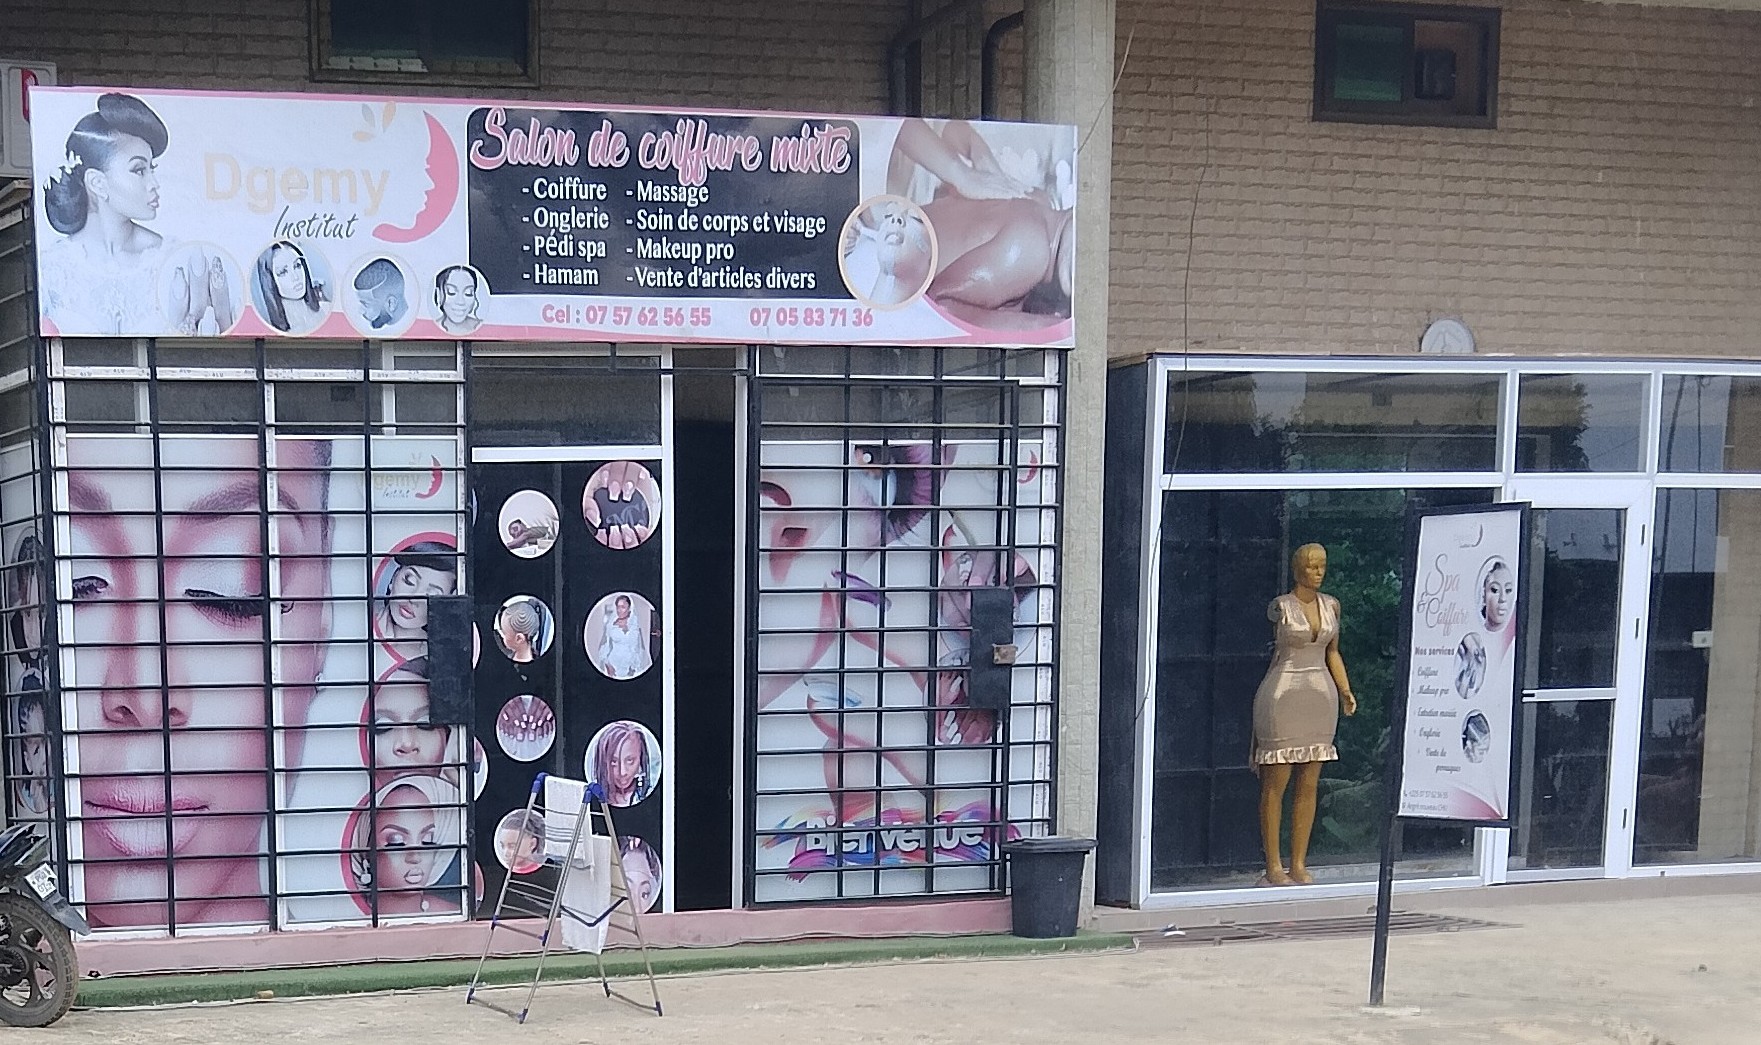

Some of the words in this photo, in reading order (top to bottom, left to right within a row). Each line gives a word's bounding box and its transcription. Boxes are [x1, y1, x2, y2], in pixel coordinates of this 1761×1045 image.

[469, 106, 580, 171] Salon
[587, 119, 630, 168] de
[638, 117, 762, 187] coiffure
[769, 123, 851, 174] mixte
[204, 151, 391, 216] Dgemy
[533, 176, 607, 200] Coiffure
[637, 180, 709, 207] Massage
[273, 205, 359, 240] Institut
[533, 205, 609, 233] Onglerie
[636, 212, 674, 231] Soin
[677, 208, 699, 231] de
[702, 213, 749, 238] corps
[752, 211, 771, 233] et
[773, 209, 827, 238] visage
[534, 228, 574, 257] Pédi
[577, 239, 606, 263] spa
[637, 235, 702, 264] Makeup
[706, 242, 735, 265] pro
[534, 263, 599, 285] Hamam
[635, 265, 684, 288] Vente
[687, 265, 762, 289] d'articles
[765, 266, 816, 289] divers
[542, 303, 571, 324] Cel
[585, 304, 608, 325] 07
[612, 305, 633, 326] 57
[637, 306, 659, 327] 62
[663, 306, 685, 327] 56
[689, 307, 712, 327] 55
[750, 307, 772, 327] 07
[775, 307, 799, 327] 05
[802, 307, 825, 327] 83
[829, 307, 847, 327] 71
[852, 307, 874, 327] 36
[1425, 553, 1460, 604] Spa
[1414, 646, 1427, 656] Nos
